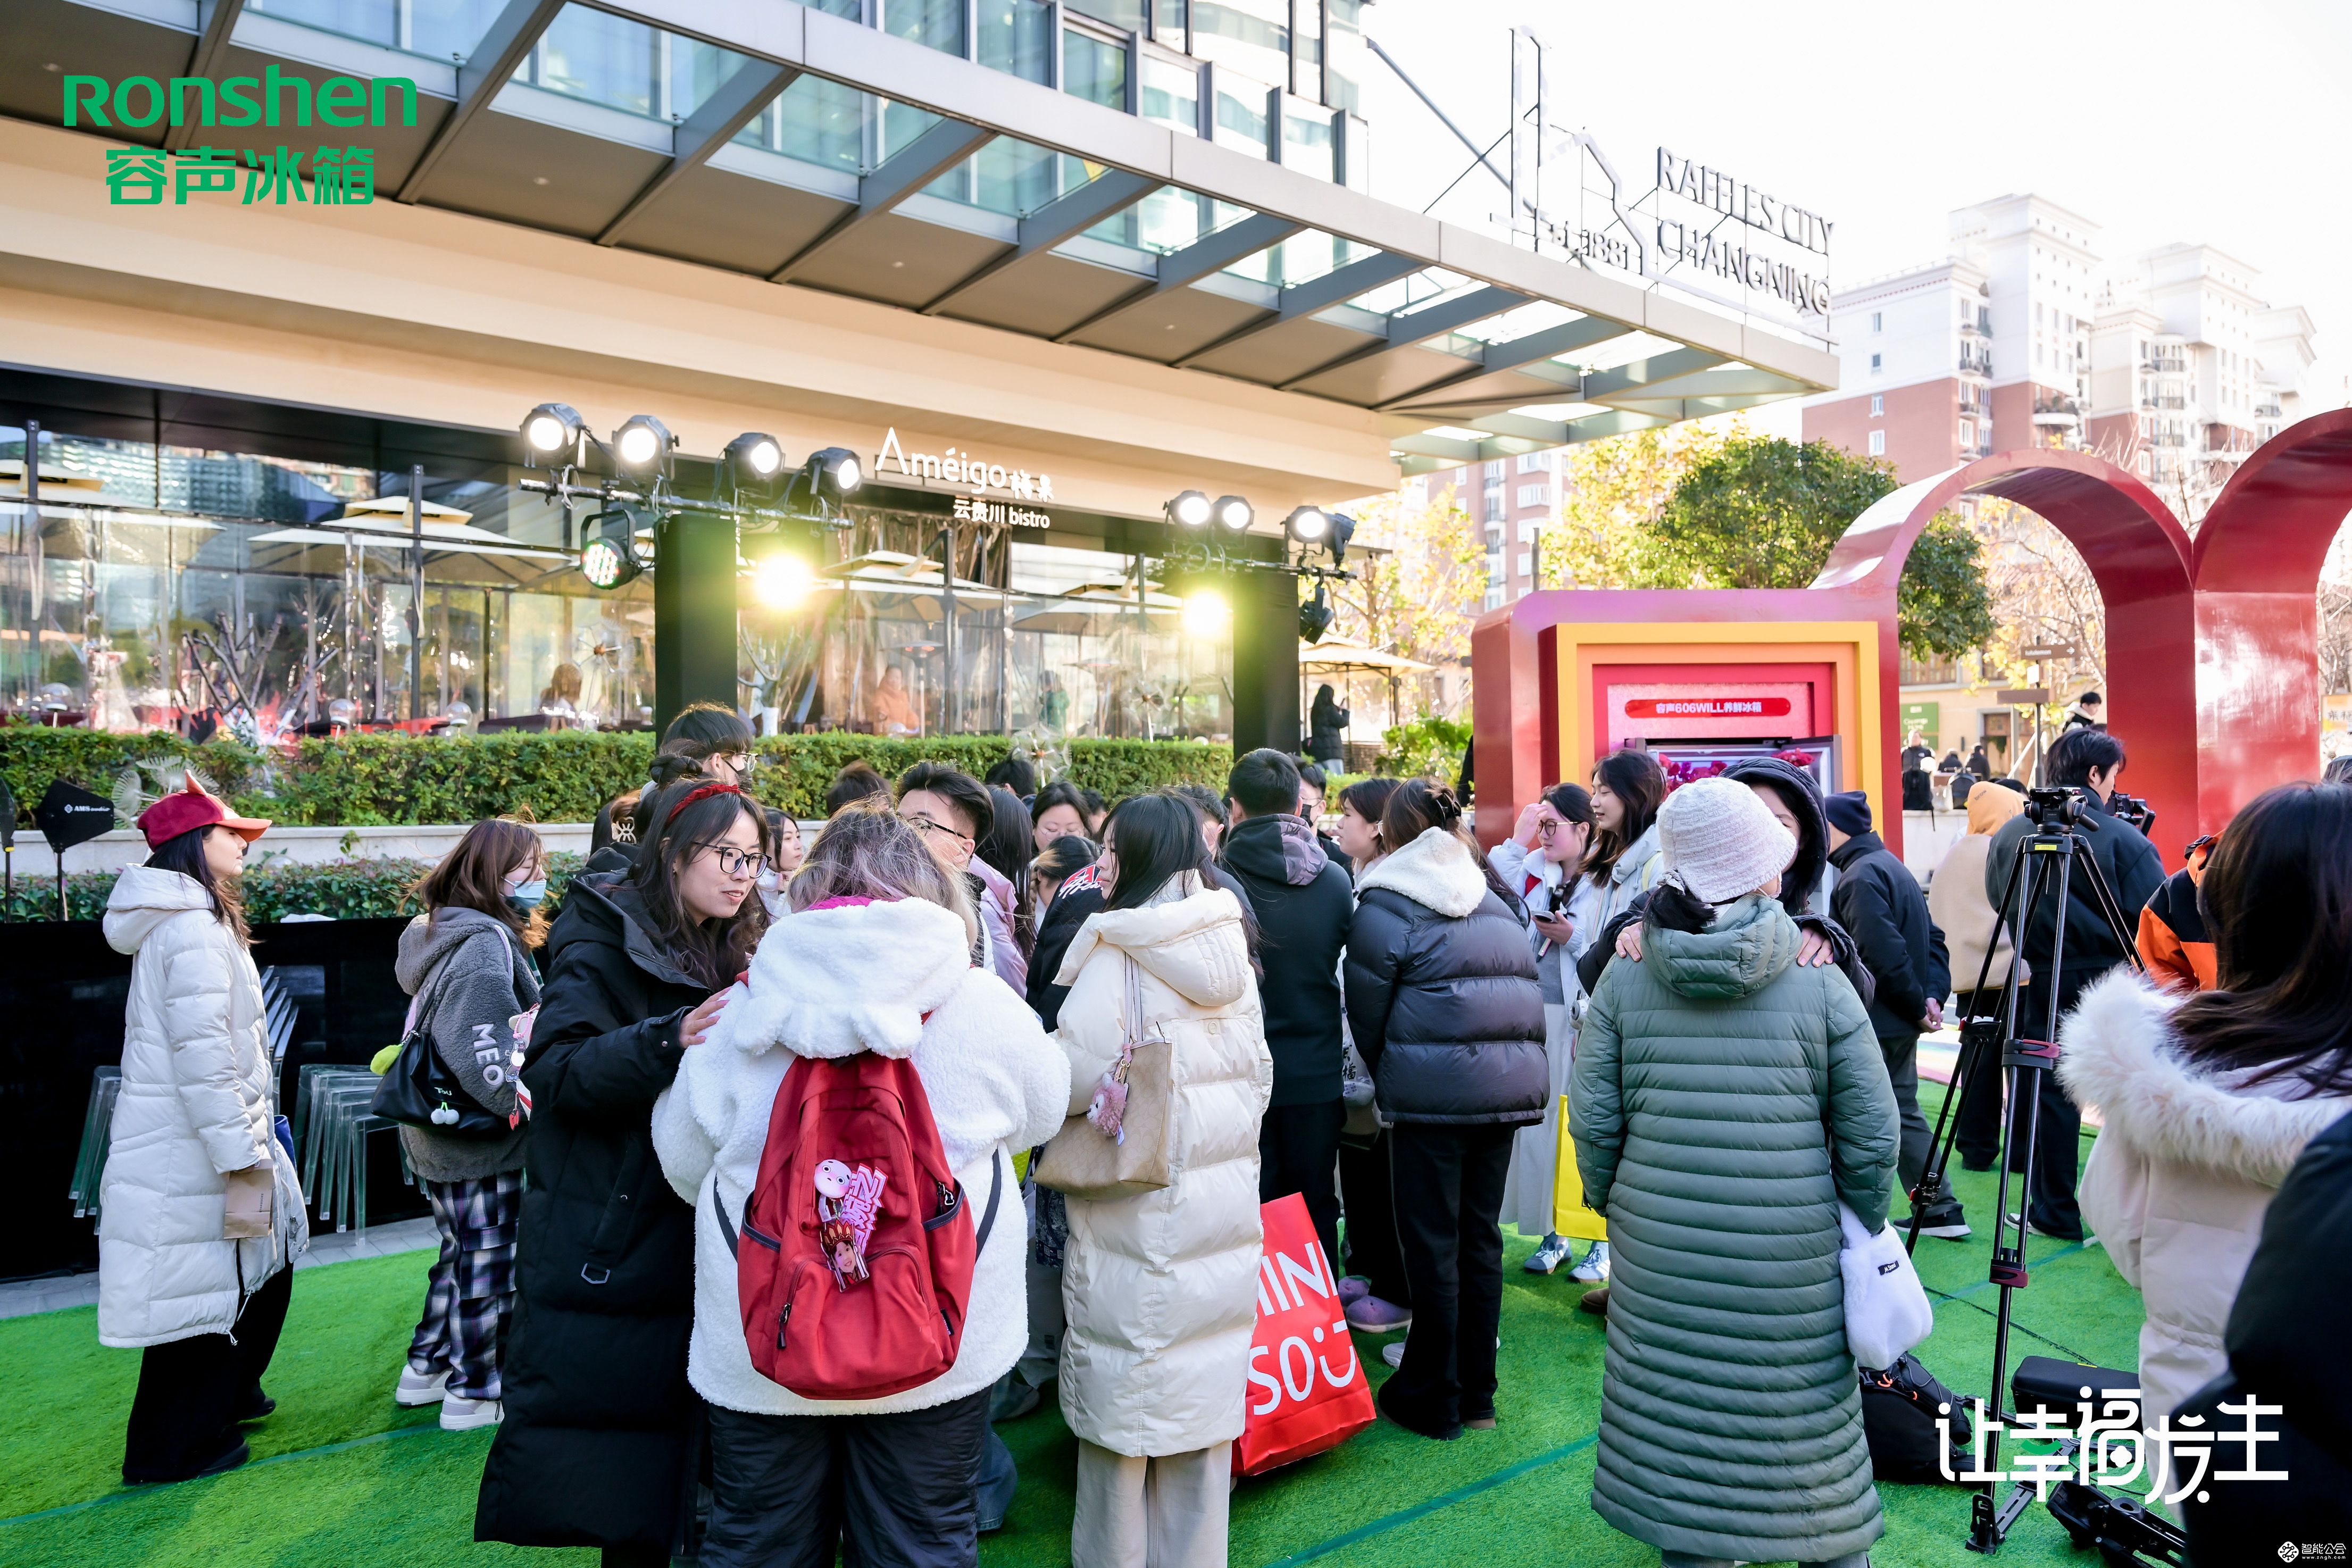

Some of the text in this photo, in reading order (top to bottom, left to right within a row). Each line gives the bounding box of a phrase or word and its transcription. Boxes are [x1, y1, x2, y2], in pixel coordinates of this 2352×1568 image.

[1657, 146, 1835, 256] RAFFLES CITY
[1657, 218, 1831, 316] CHANGNING
[1008, 506, 1050, 529] bistro
